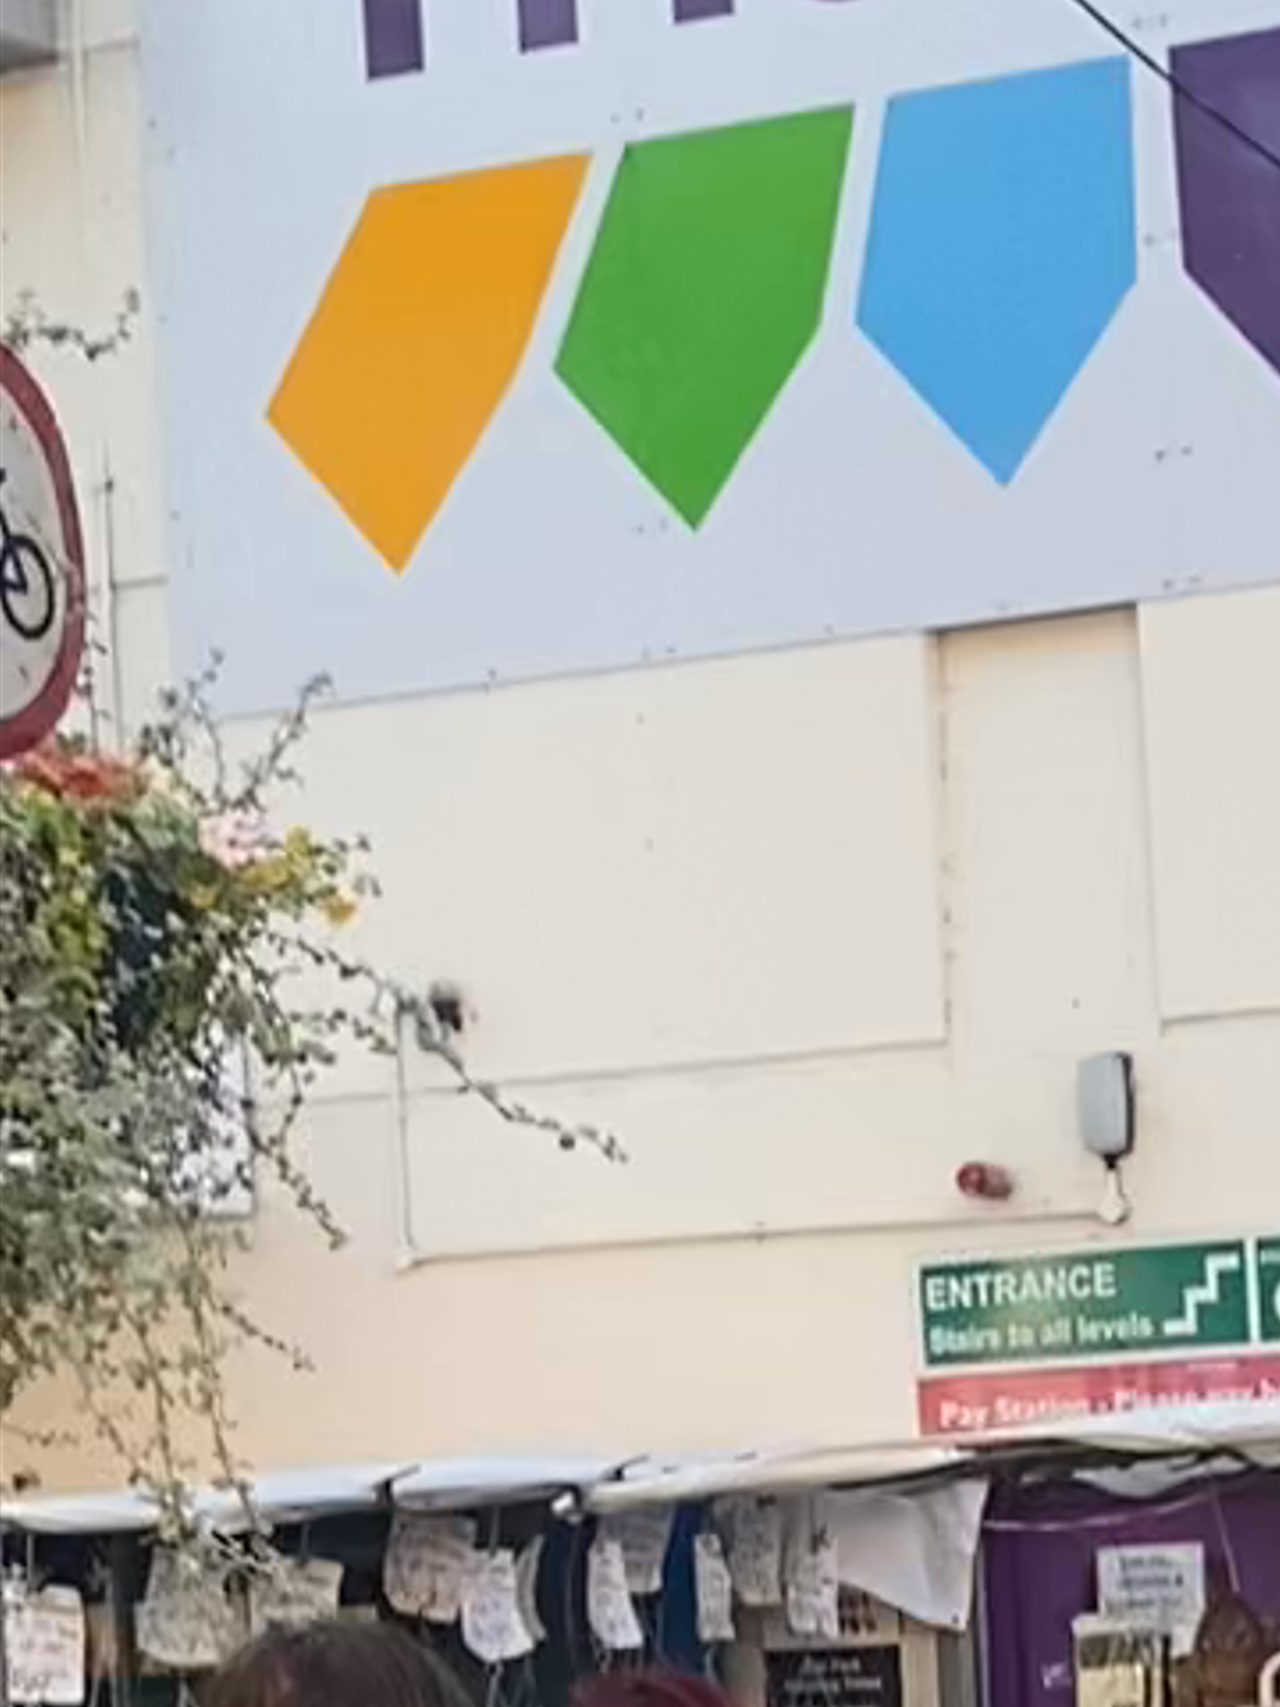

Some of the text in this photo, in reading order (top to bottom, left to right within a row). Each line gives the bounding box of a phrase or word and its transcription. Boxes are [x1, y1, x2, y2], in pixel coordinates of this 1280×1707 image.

[926, 1261, 1117, 1311] ENTRANCE
[930, 1310, 1153, 1356] Stairs to all levels
